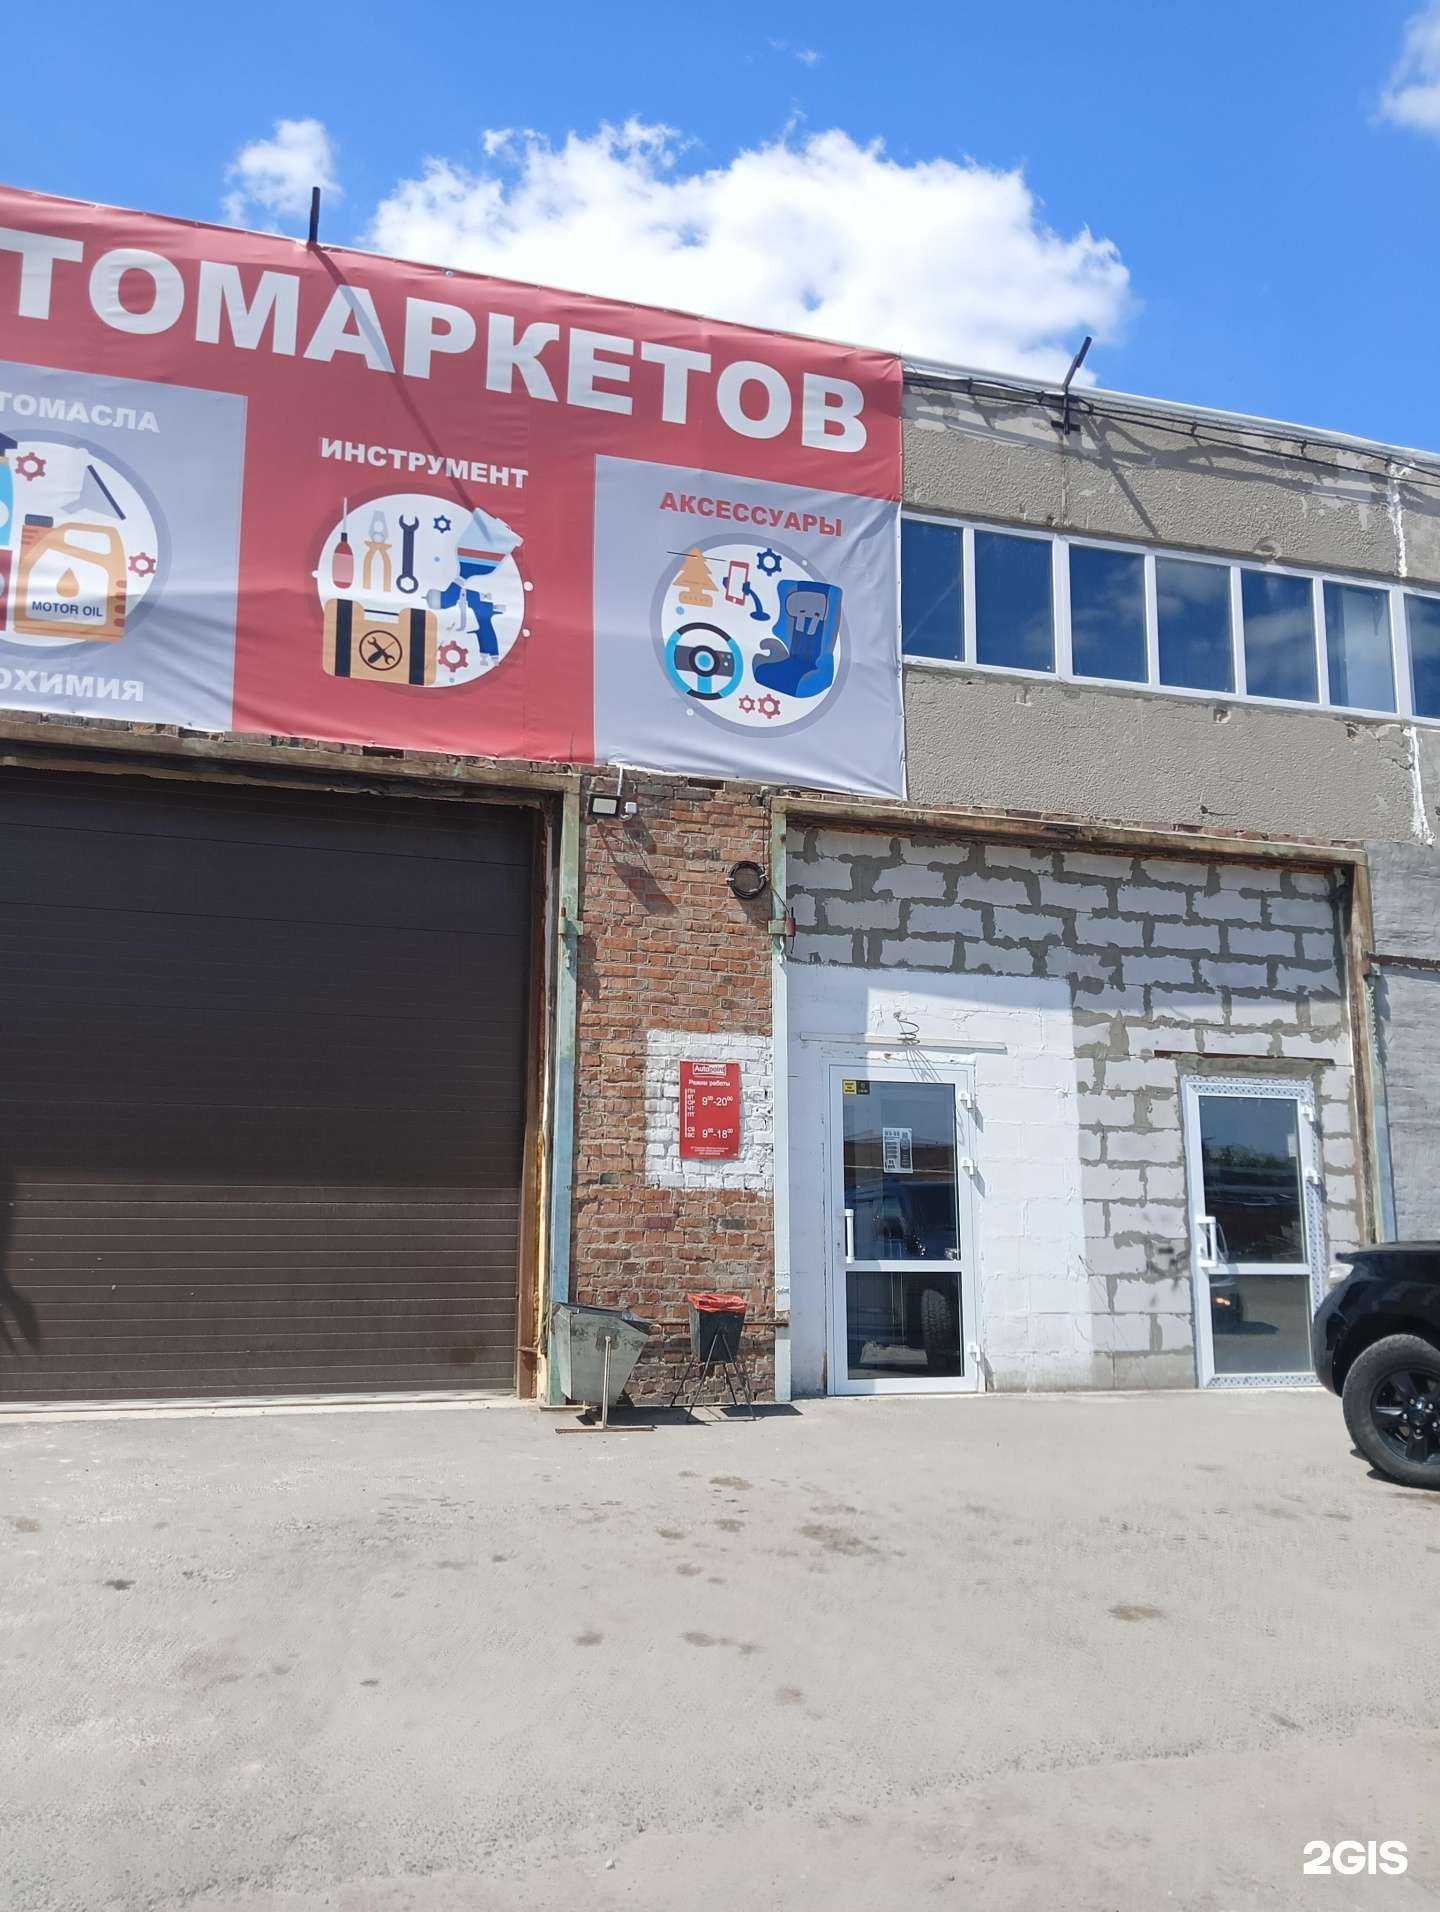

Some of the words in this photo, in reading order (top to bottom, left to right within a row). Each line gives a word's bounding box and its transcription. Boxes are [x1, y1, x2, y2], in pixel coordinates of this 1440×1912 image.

[0, 226, 867, 453] ТОМАРКЕТОВ
[320, 437, 529, 488] ИНСТРУМЕНТ
[659, 491, 842, 536] АКСЕССУАРЫ
[31, 601, 79, 615] MOTOR
[82, 606, 103, 617] OIL
